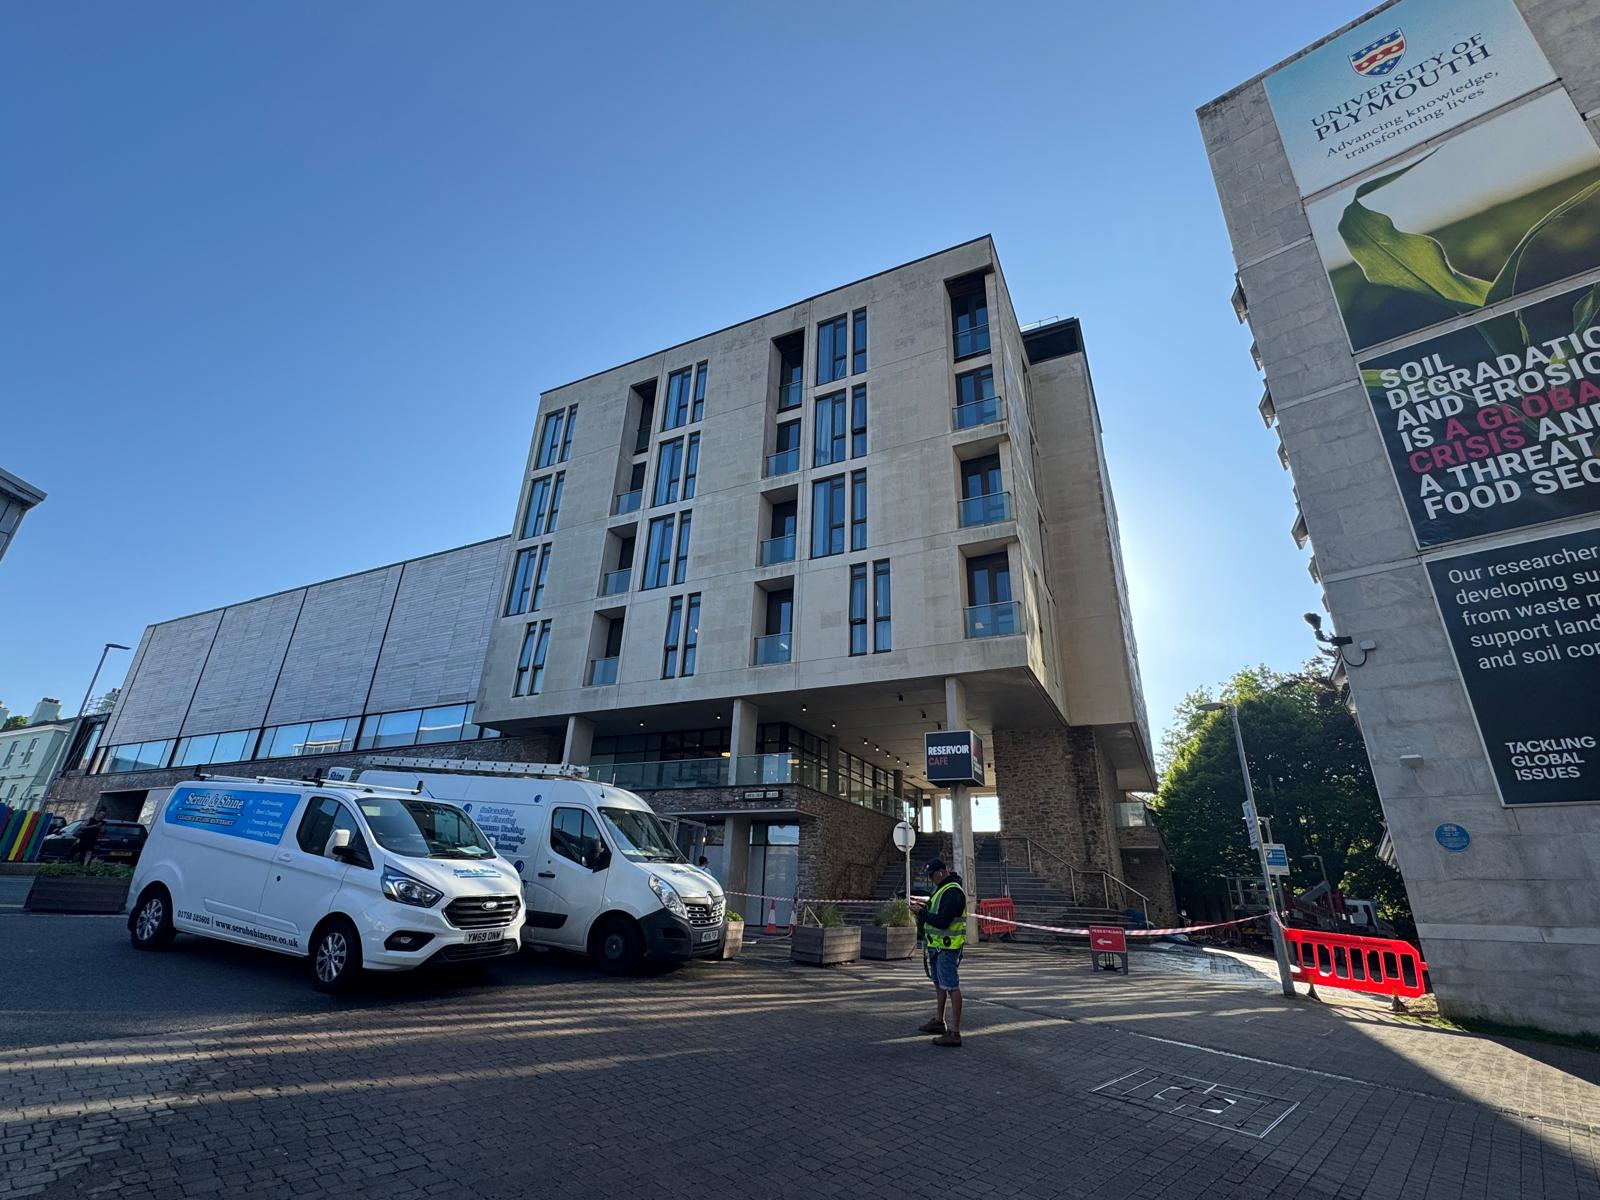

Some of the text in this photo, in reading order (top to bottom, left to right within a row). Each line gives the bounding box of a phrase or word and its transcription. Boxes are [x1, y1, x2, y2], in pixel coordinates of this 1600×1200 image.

[1310, 33, 1483, 127] UNIVERSITY OF
[1314, 44, 1492, 142] PLYMOUTH
[1326, 71, 1499, 158] Advancing knowledge,
[1345, 88, 1485, 160] transforming lives
[1380, 353, 1455, 389] SOIL
[1397, 395, 1464, 431] AND
[1400, 380, 1600, 452] IS A GLOBA
[1408, 425, 1526, 473] CRISIS
[1420, 431, 1594, 497] A THREAT
[1423, 458, 1600, 520] FOOD SEC
[1448, 545, 1600, 584] Our researcher
[1456, 570, 1600, 605] developing su
[1462, 608, 1511, 626] from
[1515, 596, 1581, 618] waste
[1470, 613, 1600, 648] support land
[1478, 650, 1517, 670] and
[1522, 644, 1561, 664] soil
[928, 744, 970, 756] RESERVOIR
[928, 756, 949, 766] CAFÉ
[1505, 736, 1597, 754] TACKLING
[1511, 752, 1585, 768] GLOBAL
[1515, 766, 1581, 781] ISSUES
[186, 792, 209, 807] Scrub
[218, 795, 244, 809] Shine
[216, 920, 298, 948] www.scrubshinesw.co.uk
